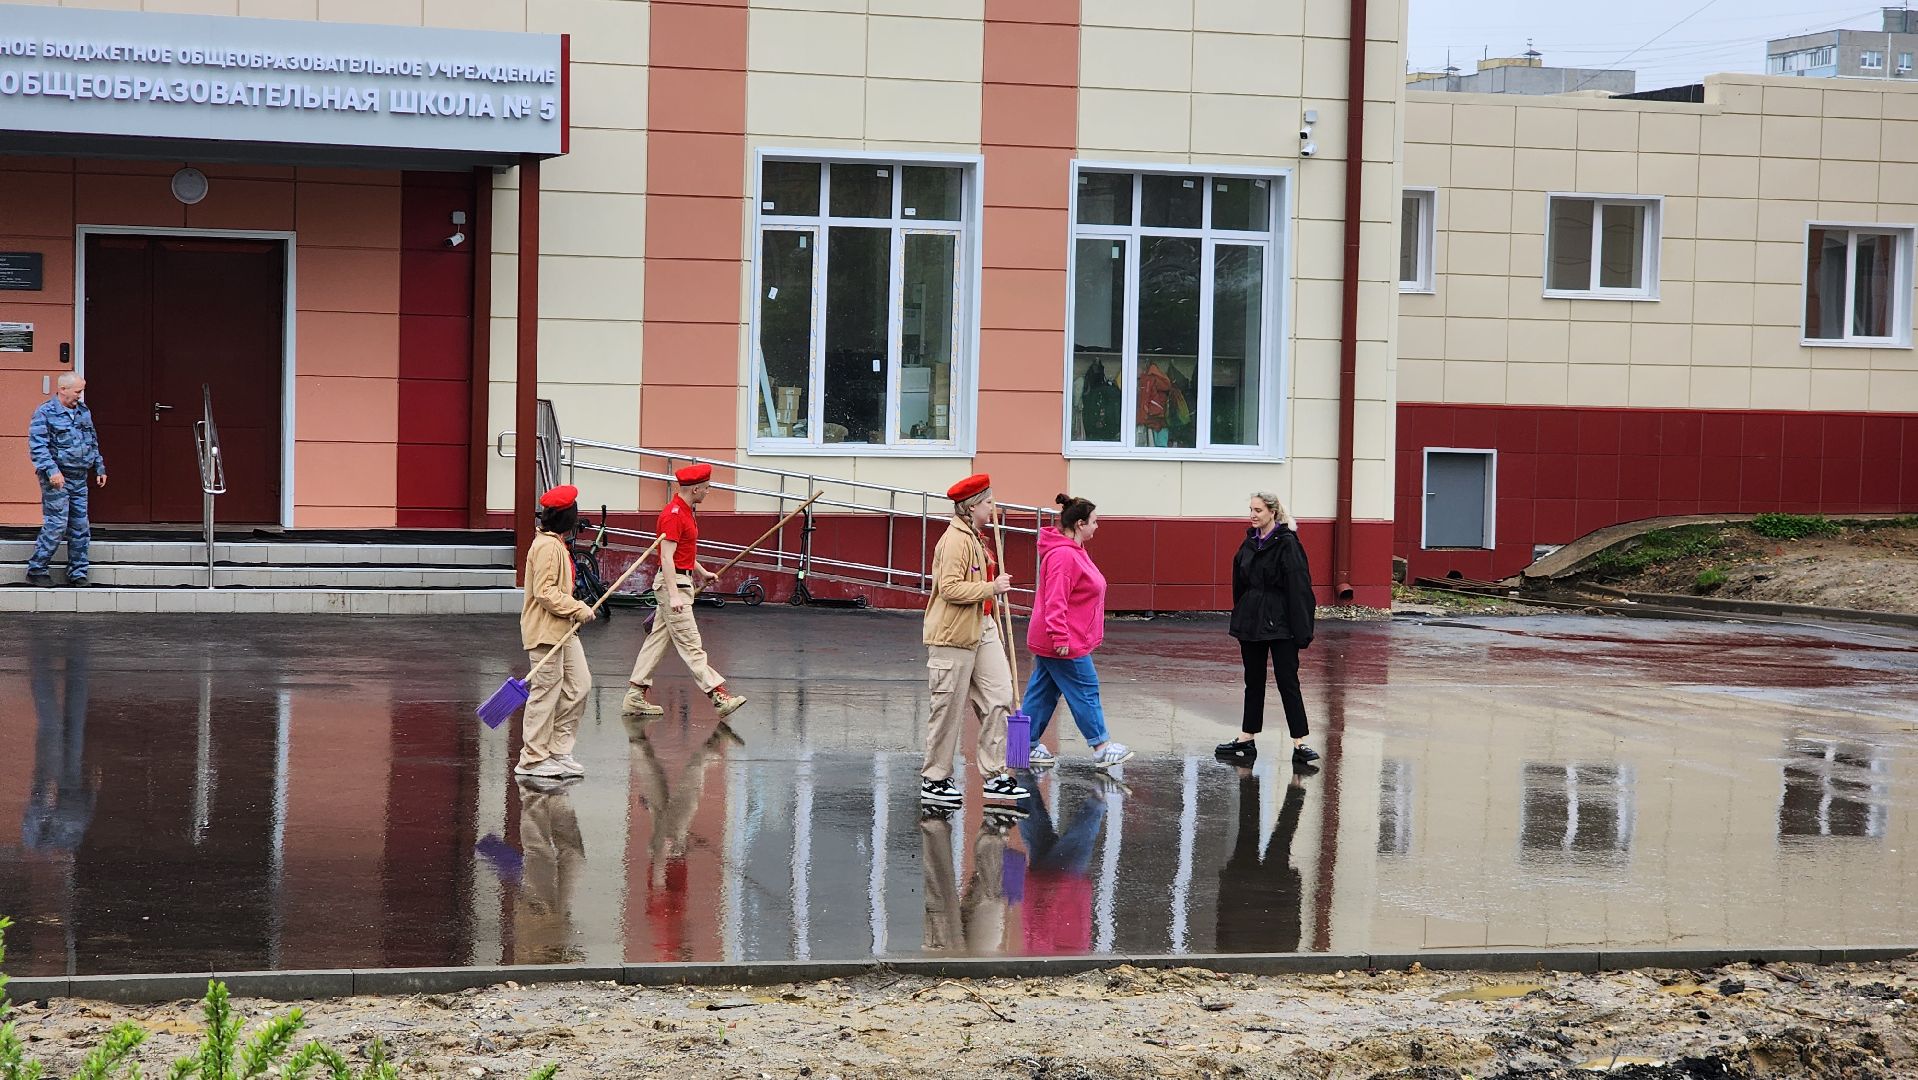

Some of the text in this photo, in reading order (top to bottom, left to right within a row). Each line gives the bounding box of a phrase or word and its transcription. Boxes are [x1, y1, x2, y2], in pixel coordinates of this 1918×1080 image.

[42, 40, 172, 63] БЮДЖЕТНОЕ
[177, 49, 422, 77] ОБЩЕОБРАЗОВАТЕЛЬНОЕ
[427, 62, 556, 83] УЧРЕЖДЕНИЕ
[0, 71, 556, 121] ОБЩЕОБРАЗОВАТЕЛЬНАЯ ШКОЛА № 5
